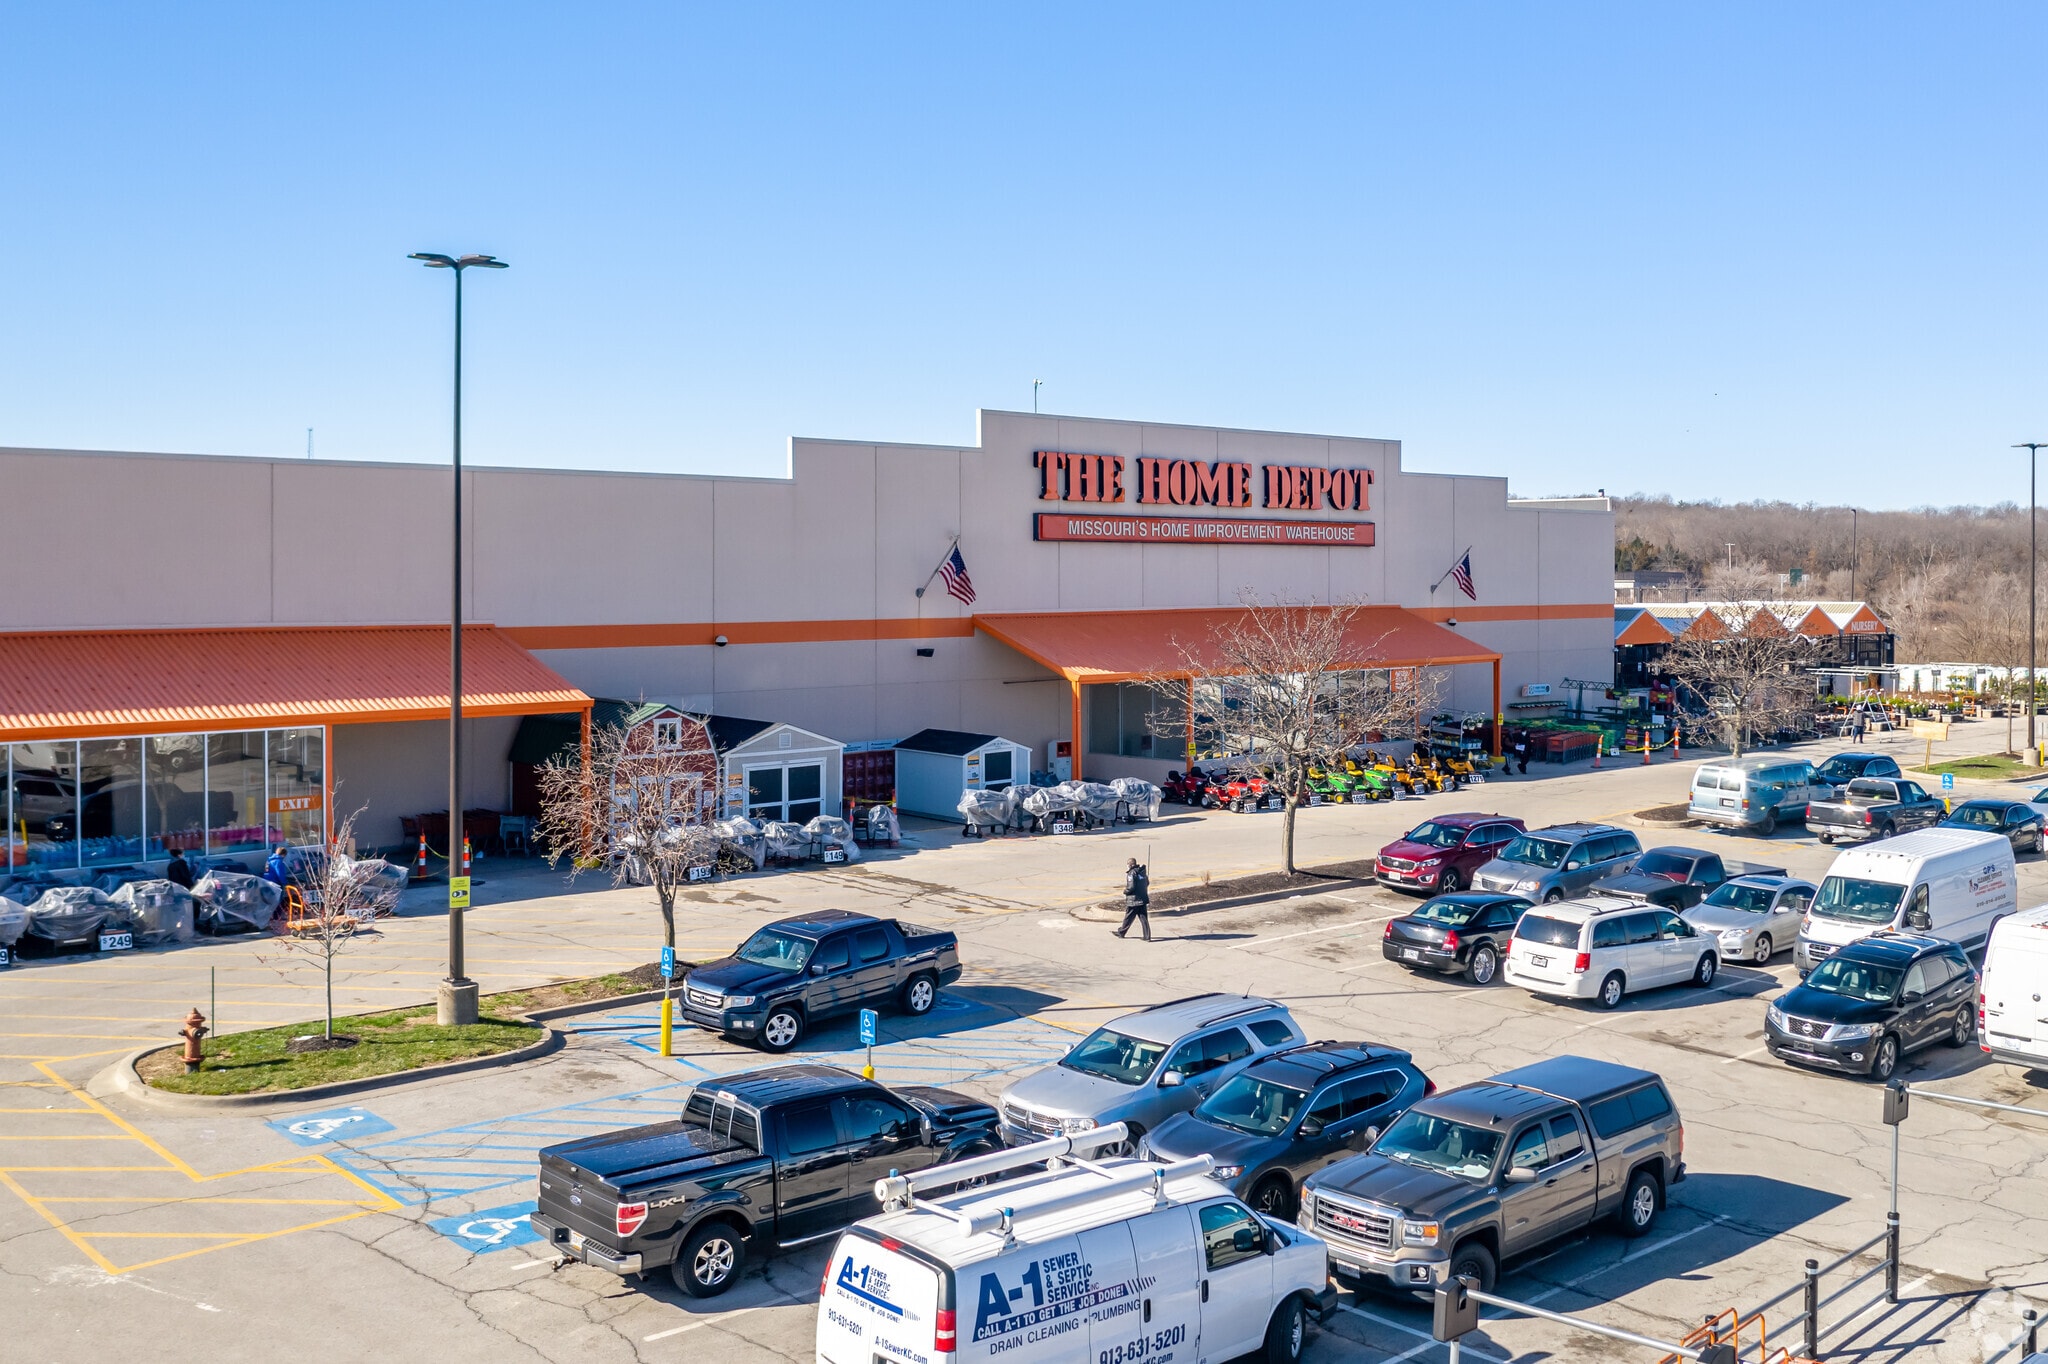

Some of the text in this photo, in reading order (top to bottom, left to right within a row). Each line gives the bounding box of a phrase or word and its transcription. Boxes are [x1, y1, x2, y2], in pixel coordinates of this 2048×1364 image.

[1034, 451, 1374, 511] THE HOME DEPOT
[1068, 519, 1355, 541] MISSOURI'S HOME IMPROVEMENT WAREHOUSE
[1851, 620, 1878, 631] NURSERY
[279, 797, 311, 811] EXIT
[1333, 1213, 1367, 1231] GMC
[837, 1256, 870, 1289] A-1
[870, 1267, 887, 1281] SEWER
[1042, 1252, 1079, 1274] SEWER
[874, 1277, 891, 1292] SEPTIC
[1045, 1263, 1093, 1289] & SEPTIC
[867, 1283, 887, 1299] SERVICE
[973, 1260, 1044, 1332] A-1
[1047, 1279, 1090, 1304] SERVICE
[828, 1308, 862, 1336] 913-631-5201
[876, 1308, 886, 1318] JOB
[977, 1285, 1124, 1339] CALL A-1 TO GET THE JOB DONE!
[990, 1299, 1141, 1355] DRAIN CLEANING PLUMBING
[875, 1335, 928, 1364] A-1SewerKC.com
[1099, 1323, 1186, 1364] 913-631-5201
